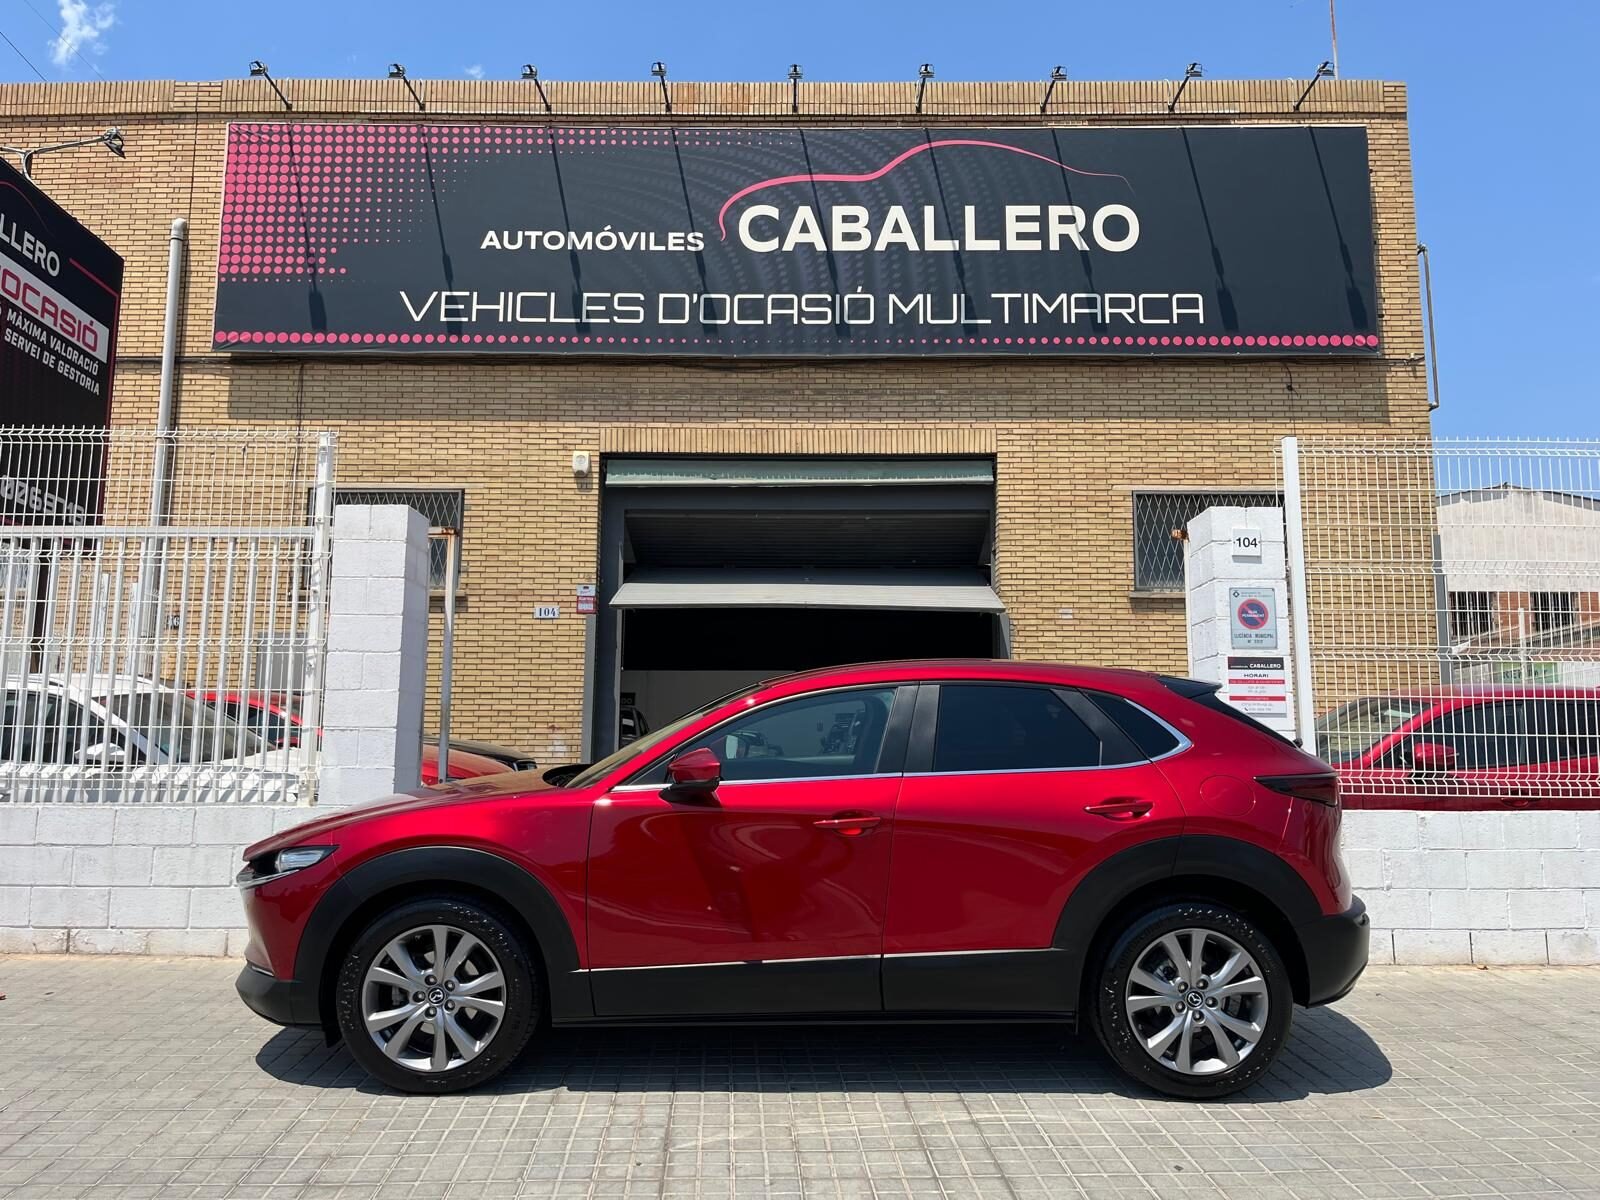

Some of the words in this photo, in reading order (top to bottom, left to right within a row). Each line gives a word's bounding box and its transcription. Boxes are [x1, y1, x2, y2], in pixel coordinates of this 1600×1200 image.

[480, 225, 705, 252] AUTOMÓVILES
[738, 204, 1140, 252] CABALLERO
[400, 291, 645, 325] VEHICLES
[888, 292, 1205, 325] MULTIMARCA
[4, 328, 40, 360] SERVEI
[42, 350, 56, 369] DE
[57, 360, 100, 395] GESTORIA
[50, 335, 99, 376] VALORACIÓ
[1236, 537, 1258, 548] 104
[539, 607, 556, 617] 104
